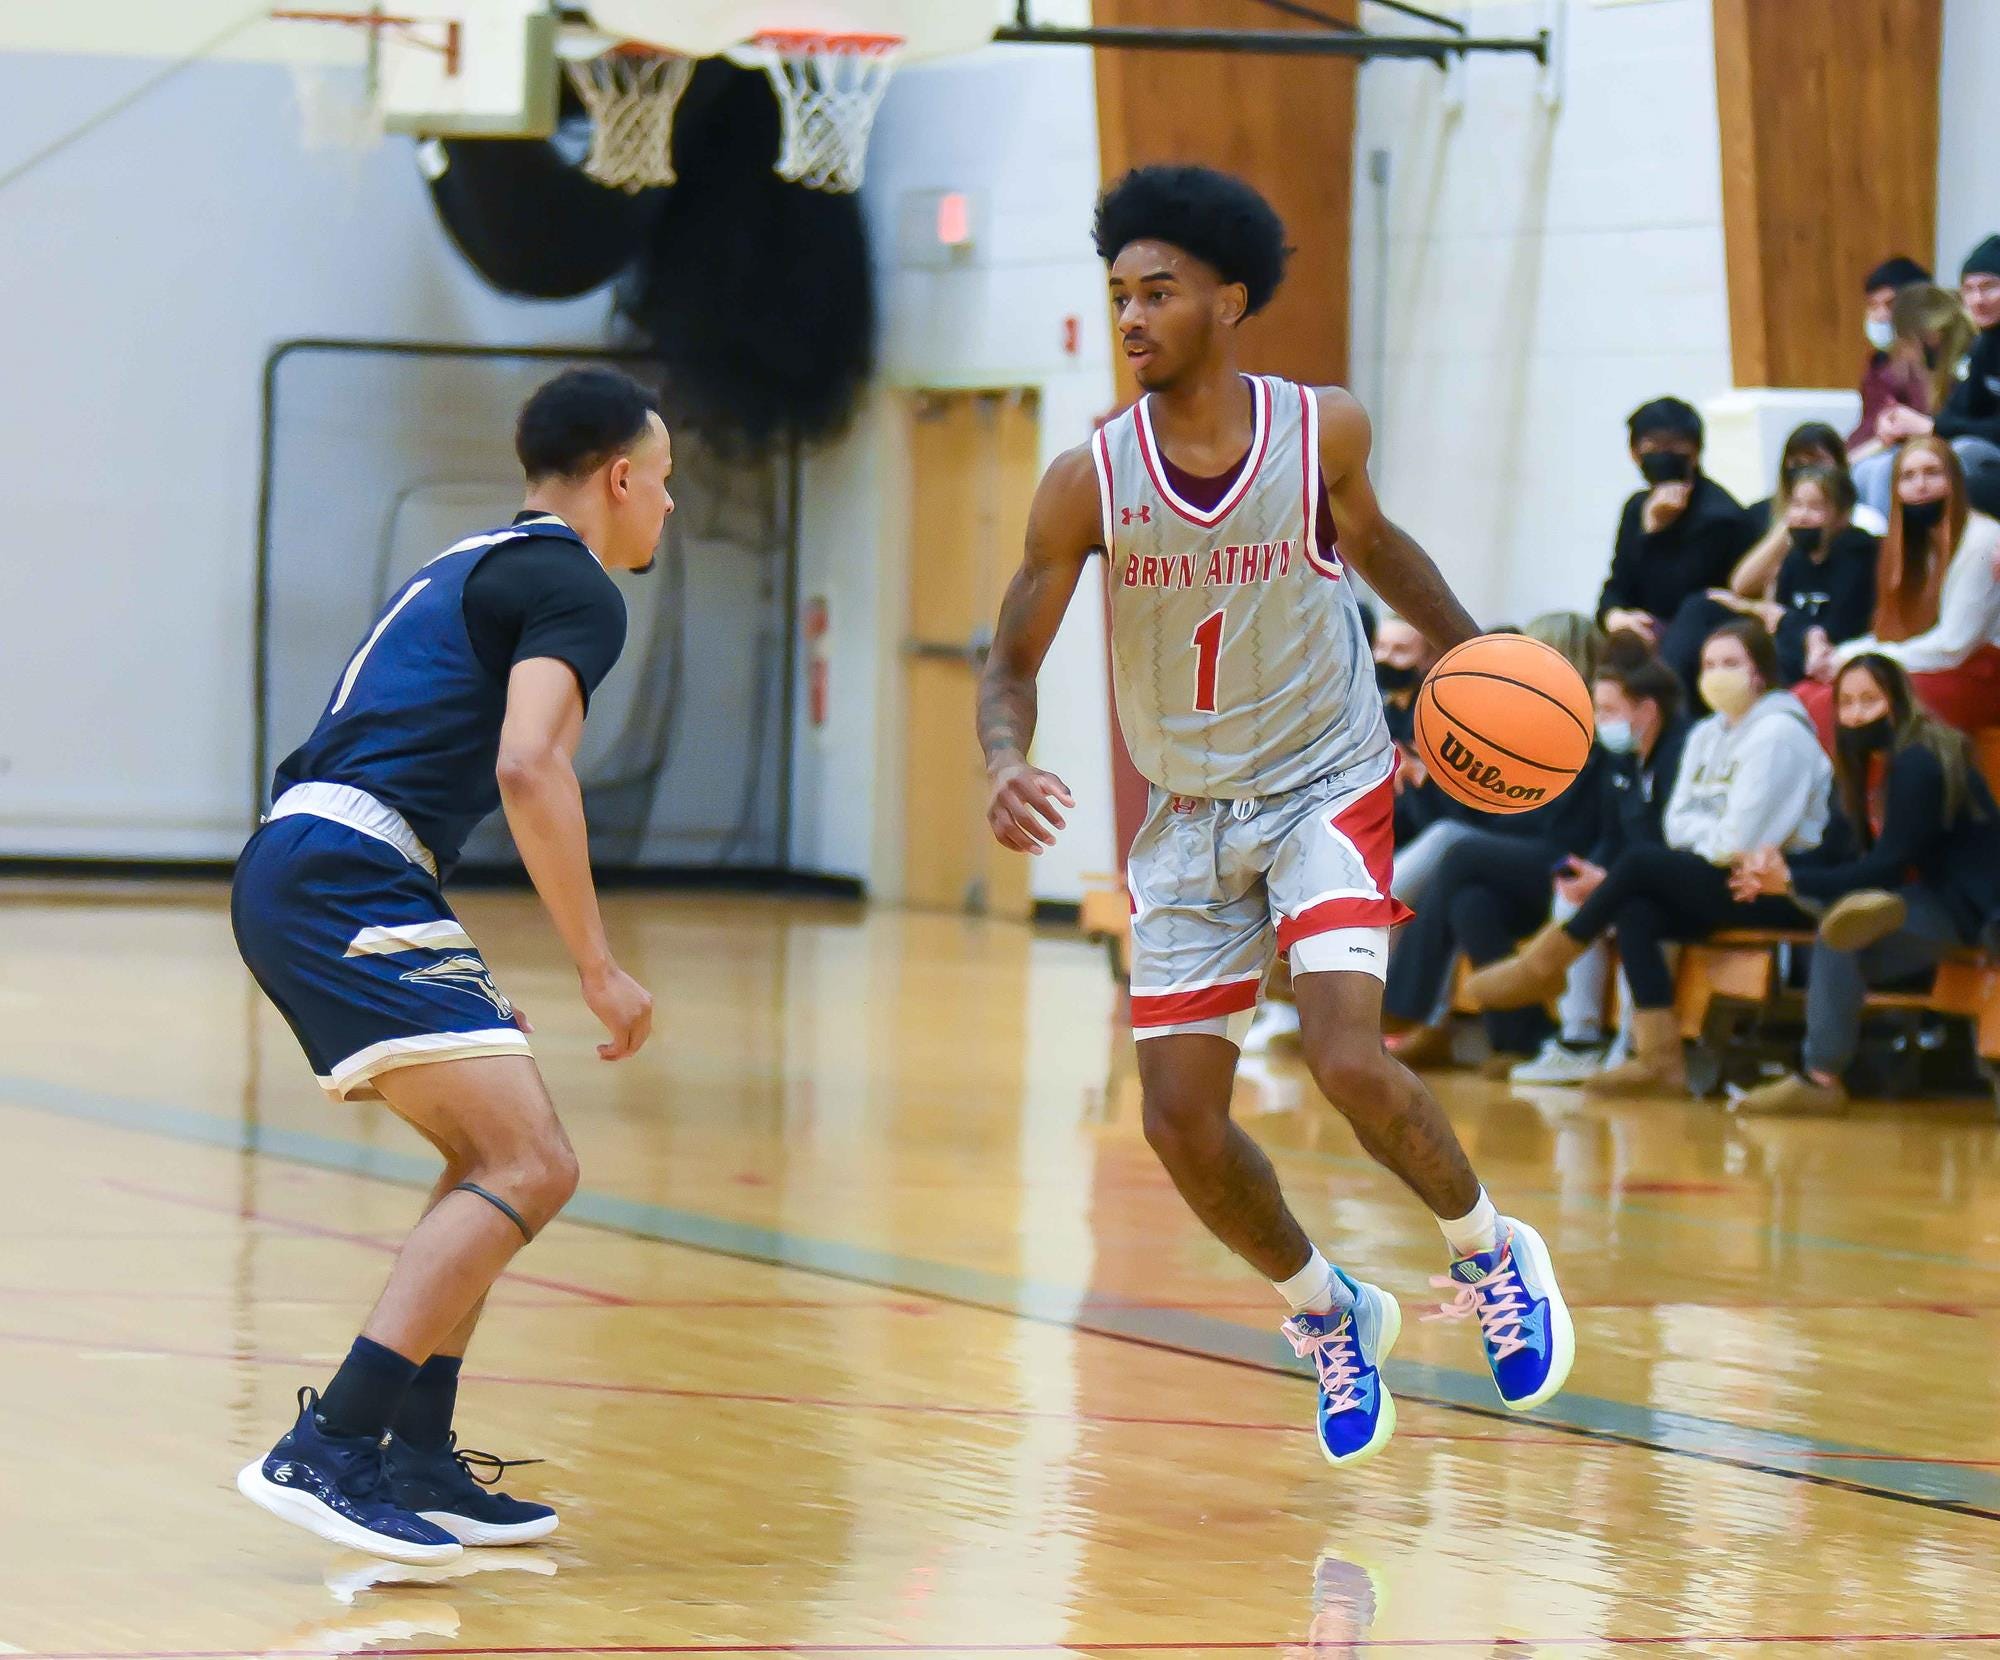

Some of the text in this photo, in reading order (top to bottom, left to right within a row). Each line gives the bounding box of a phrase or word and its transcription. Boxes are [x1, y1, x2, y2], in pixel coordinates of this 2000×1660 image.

[1124, 540, 1297, 590] BRYN ATHYN
[1190, 607, 1227, 715] 1
[1439, 731, 1547, 800] Wilson
